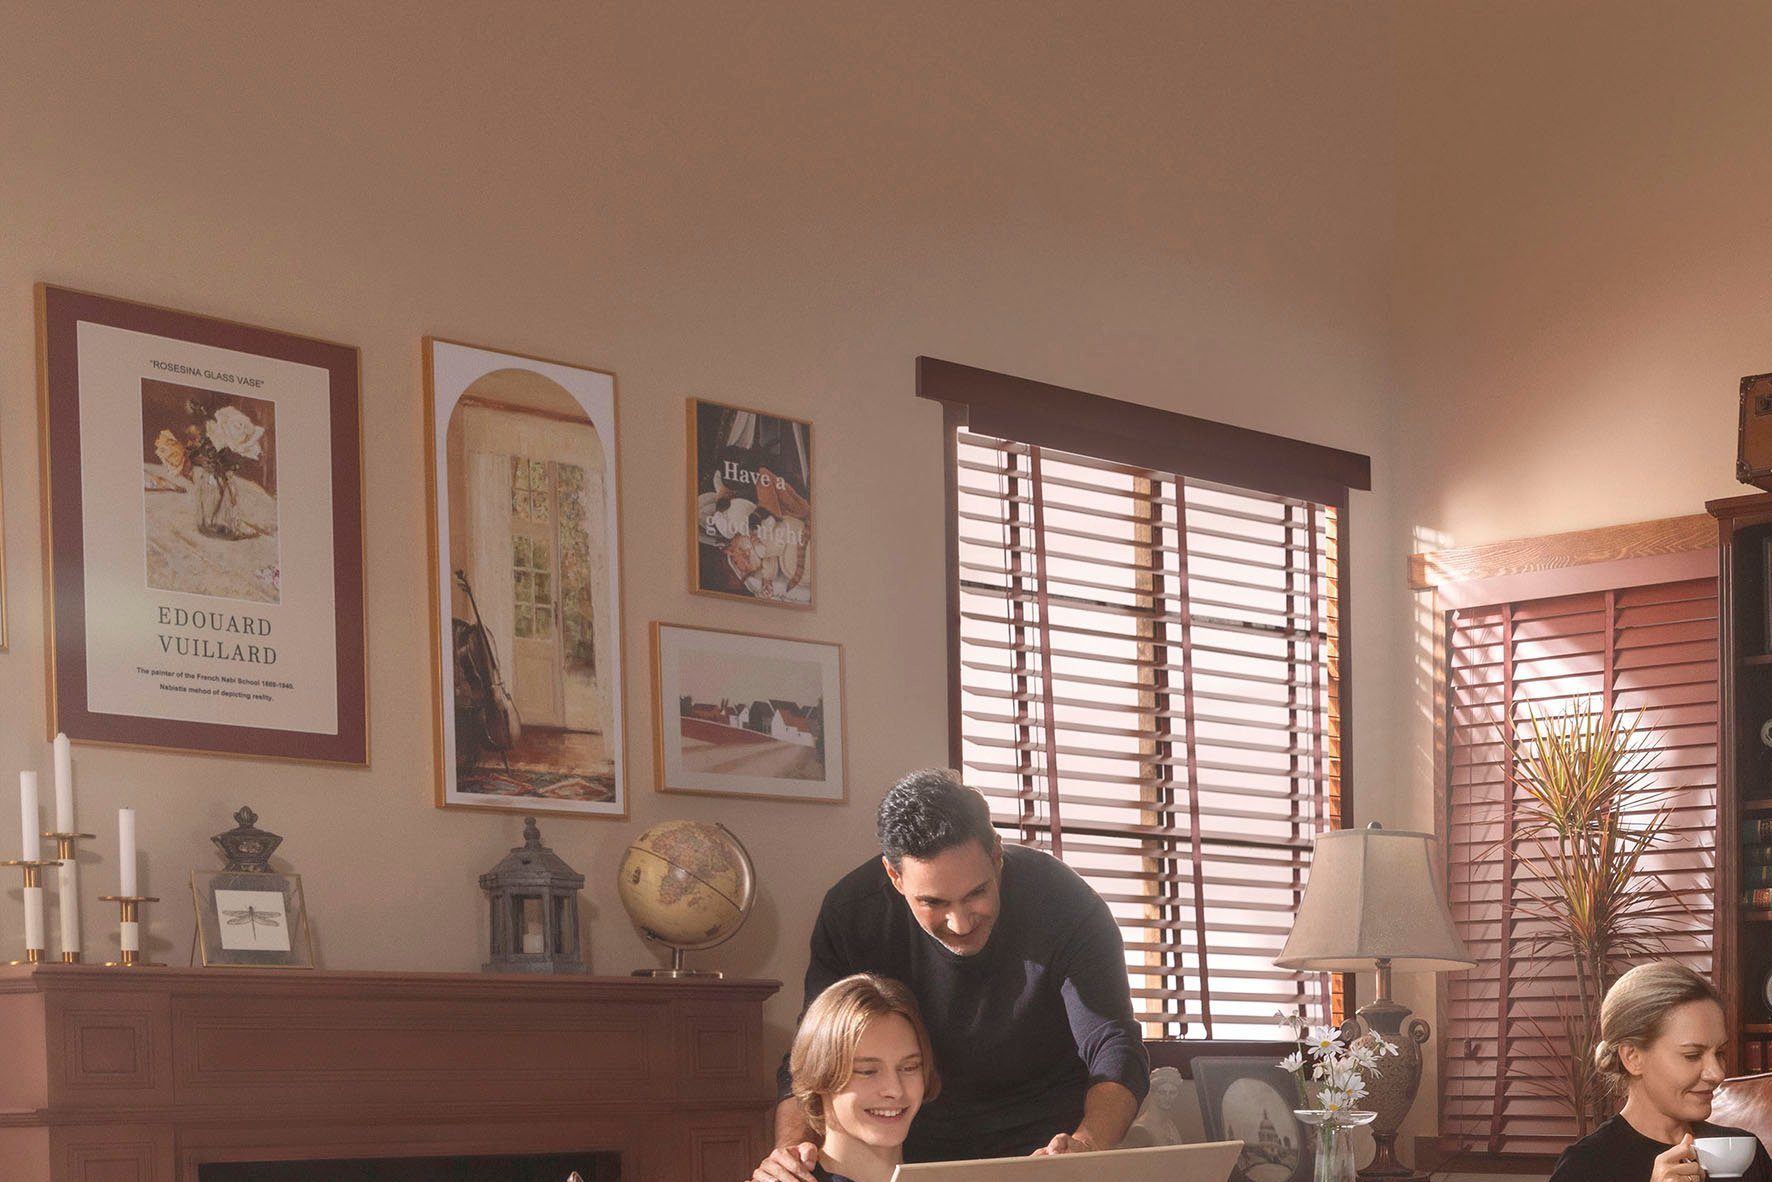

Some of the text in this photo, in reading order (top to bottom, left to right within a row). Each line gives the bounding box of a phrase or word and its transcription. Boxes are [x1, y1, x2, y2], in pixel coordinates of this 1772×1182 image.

[203, 370, 235, 384] GLASS
[723, 460, 786, 490] Have a
[158, 606, 271, 636] EDOUARD
[158, 635, 276, 664] VUILLARD
[151, 670, 174, 678] painter
[185, 672, 195, 680] the
[196, 674, 220, 682] French
[238, 678, 260, 686] School
[221, 690, 250, 700] depicting
